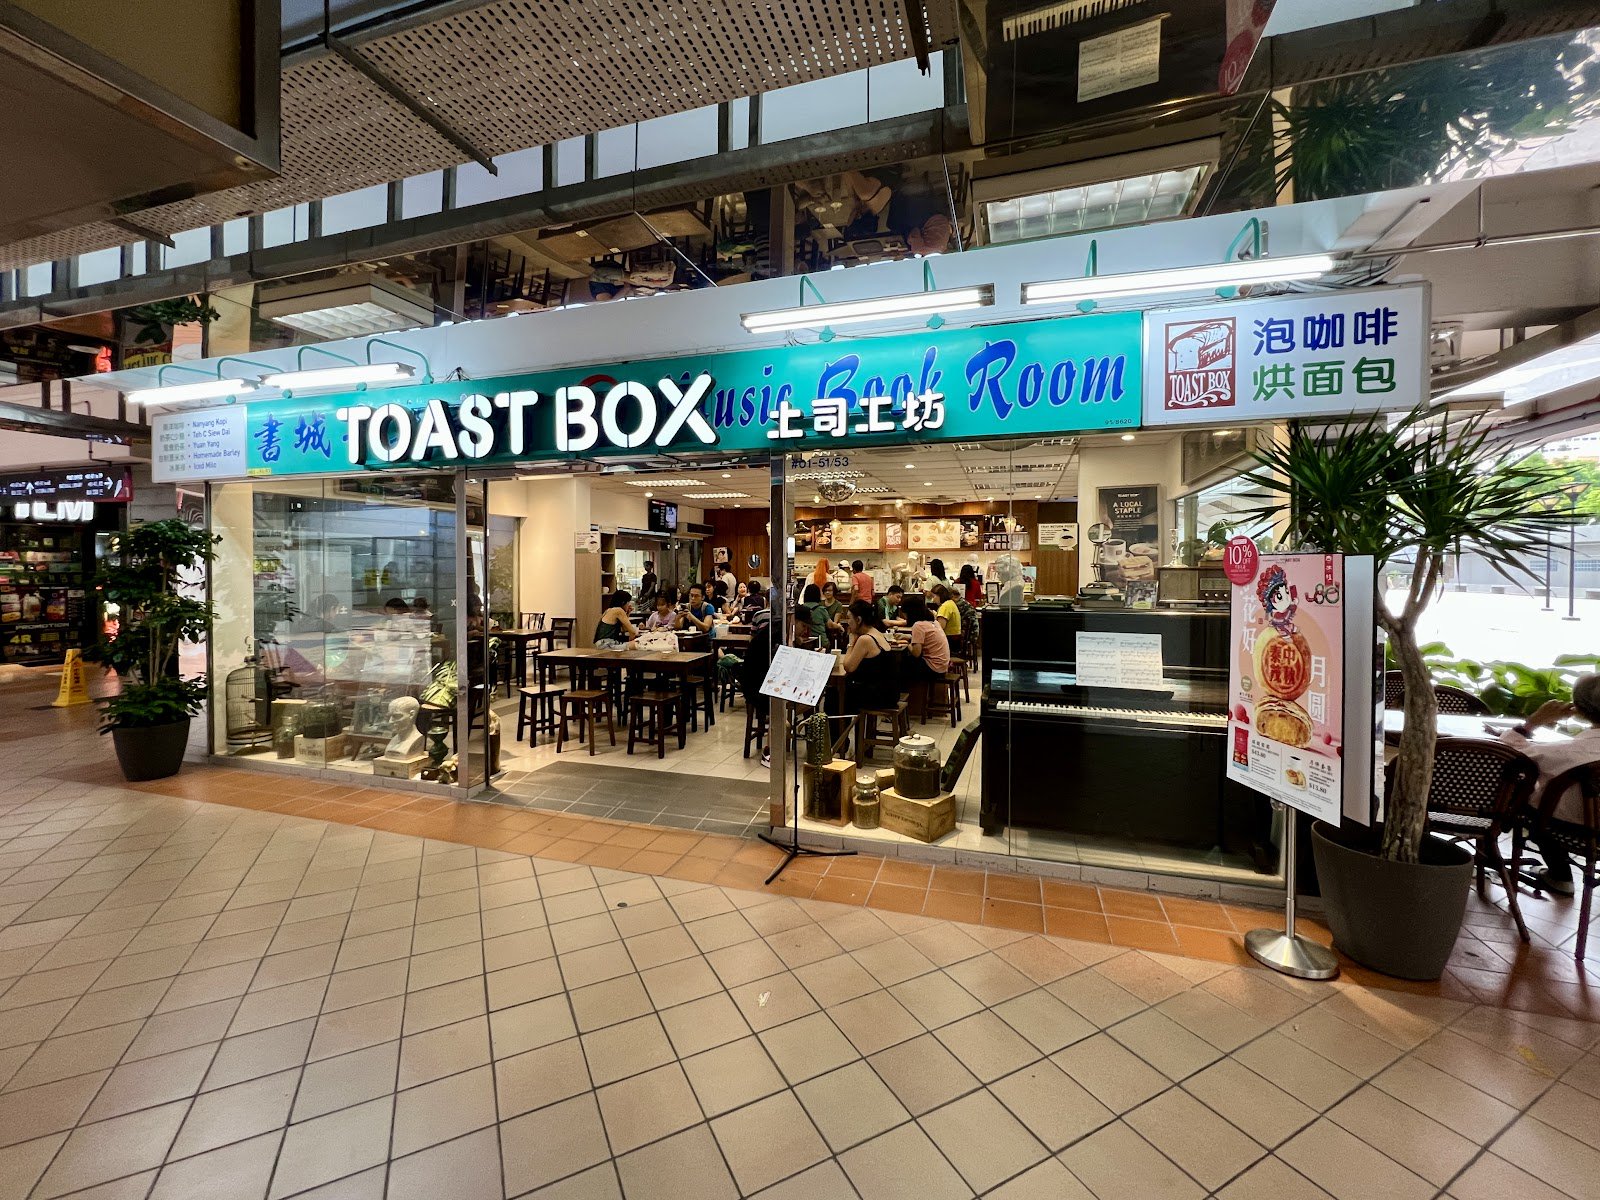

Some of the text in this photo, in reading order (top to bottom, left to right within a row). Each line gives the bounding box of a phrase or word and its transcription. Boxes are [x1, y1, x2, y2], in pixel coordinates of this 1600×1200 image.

[1253, 307, 1398, 356] 泡咖啡
[666, 361, 792, 430] usic
[965, 338, 1126, 421] Room
[1170, 371, 1231, 402] TOAST BOX
[1252, 356, 1397, 401] 烘面包
[192, 418, 228, 428] Nanyang Kopi
[336, 374, 717, 464] TOAST BOX
[767, 388, 945, 439] 土司工坊
[192, 430, 203, 438] Teh
[208, 429, 220, 437] Siew
[221, 428, 231, 436] Dai
[206, 441, 220, 449] Yang
[193, 449, 241, 459] Homemade Barley
[791, 456, 849, 470] #01-51/53
[1228, 544, 1252, 565] 10%
